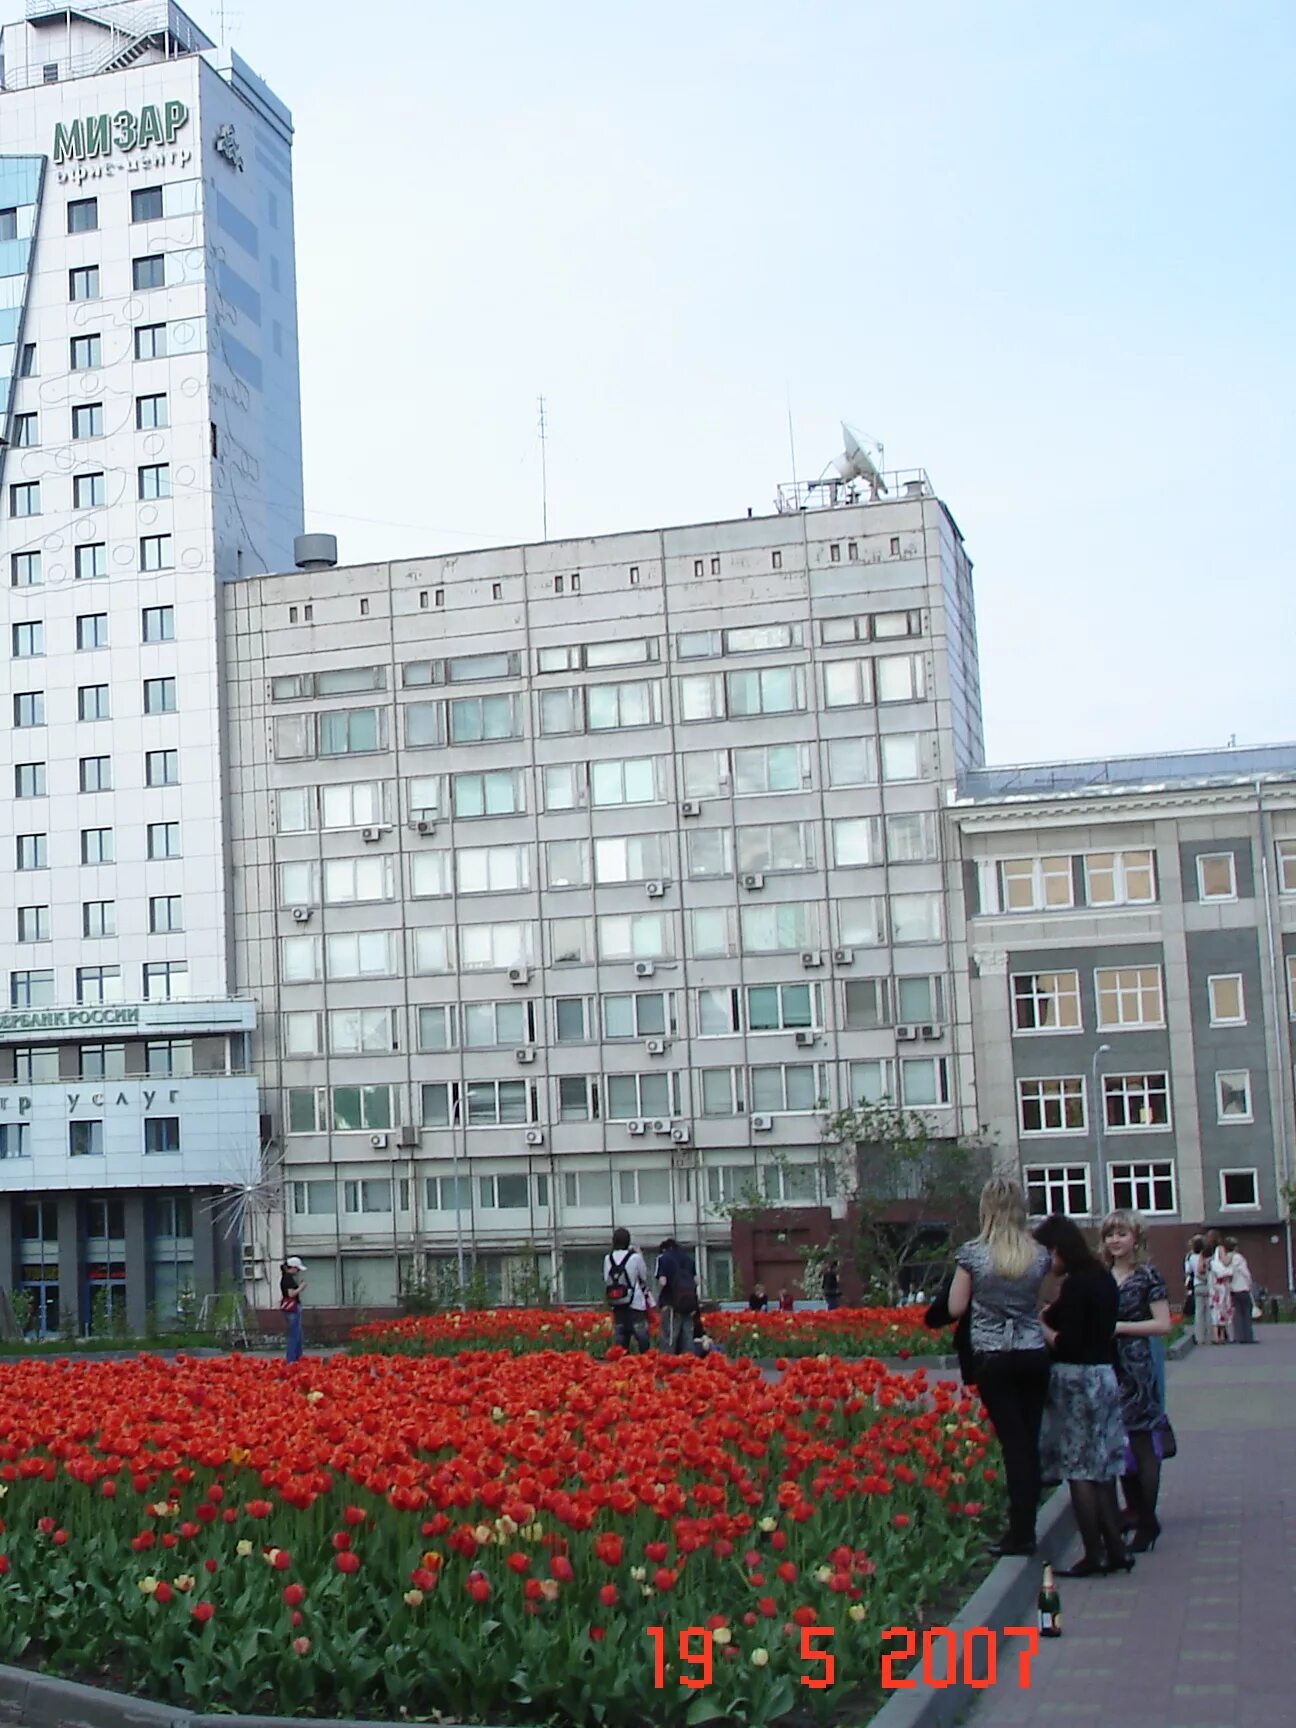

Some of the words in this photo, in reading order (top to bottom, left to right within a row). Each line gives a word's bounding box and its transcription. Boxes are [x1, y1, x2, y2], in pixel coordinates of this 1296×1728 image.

[53, 100, 190, 166] МИЗАР
[68, 1008, 140, 1025] РОССИИ
[67, 1089, 180, 1113] услуг
